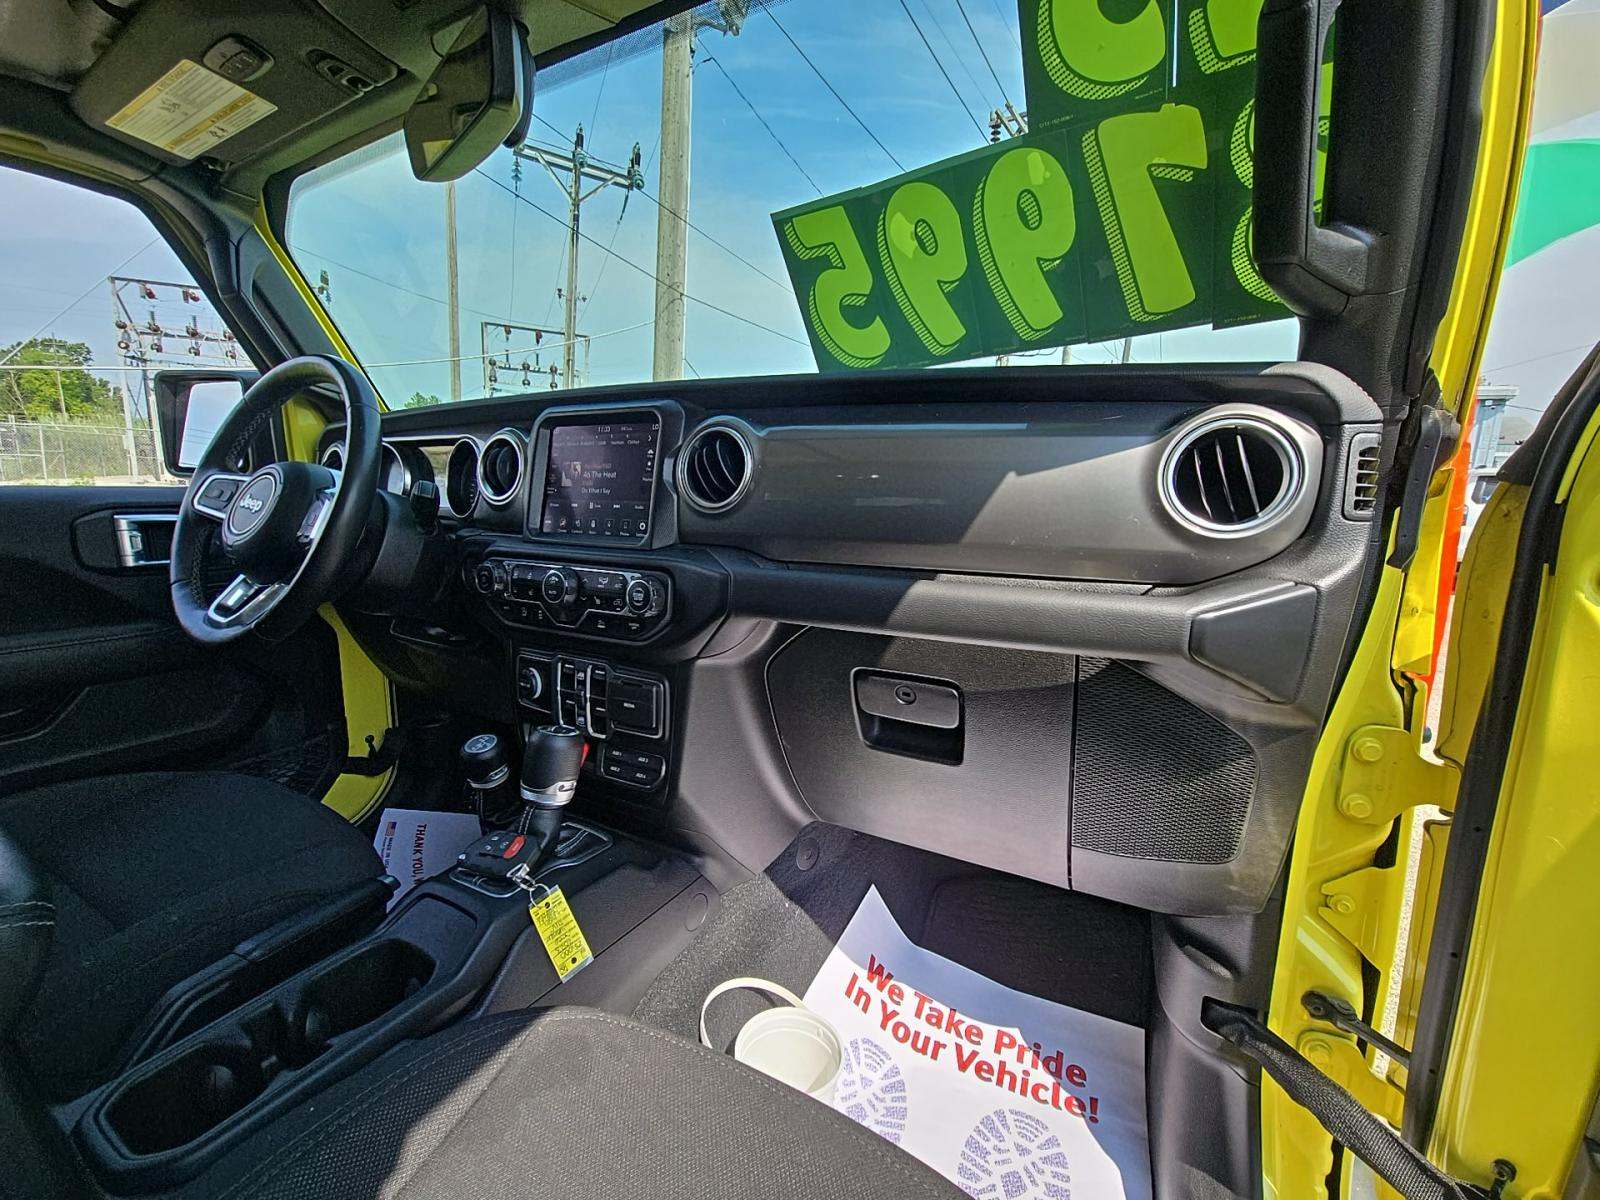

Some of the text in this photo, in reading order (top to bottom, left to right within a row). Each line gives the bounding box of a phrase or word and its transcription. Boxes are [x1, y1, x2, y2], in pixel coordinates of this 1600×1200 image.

[239, 493, 263, 513] Jeep
[412, 823, 427, 855] THANK
[844, 972, 872, 1014] In
[880, 999, 947, 1061] Your
[954, 1042, 1099, 1124] Vehicle!
[866, 954, 1088, 1088] We Take Pride
